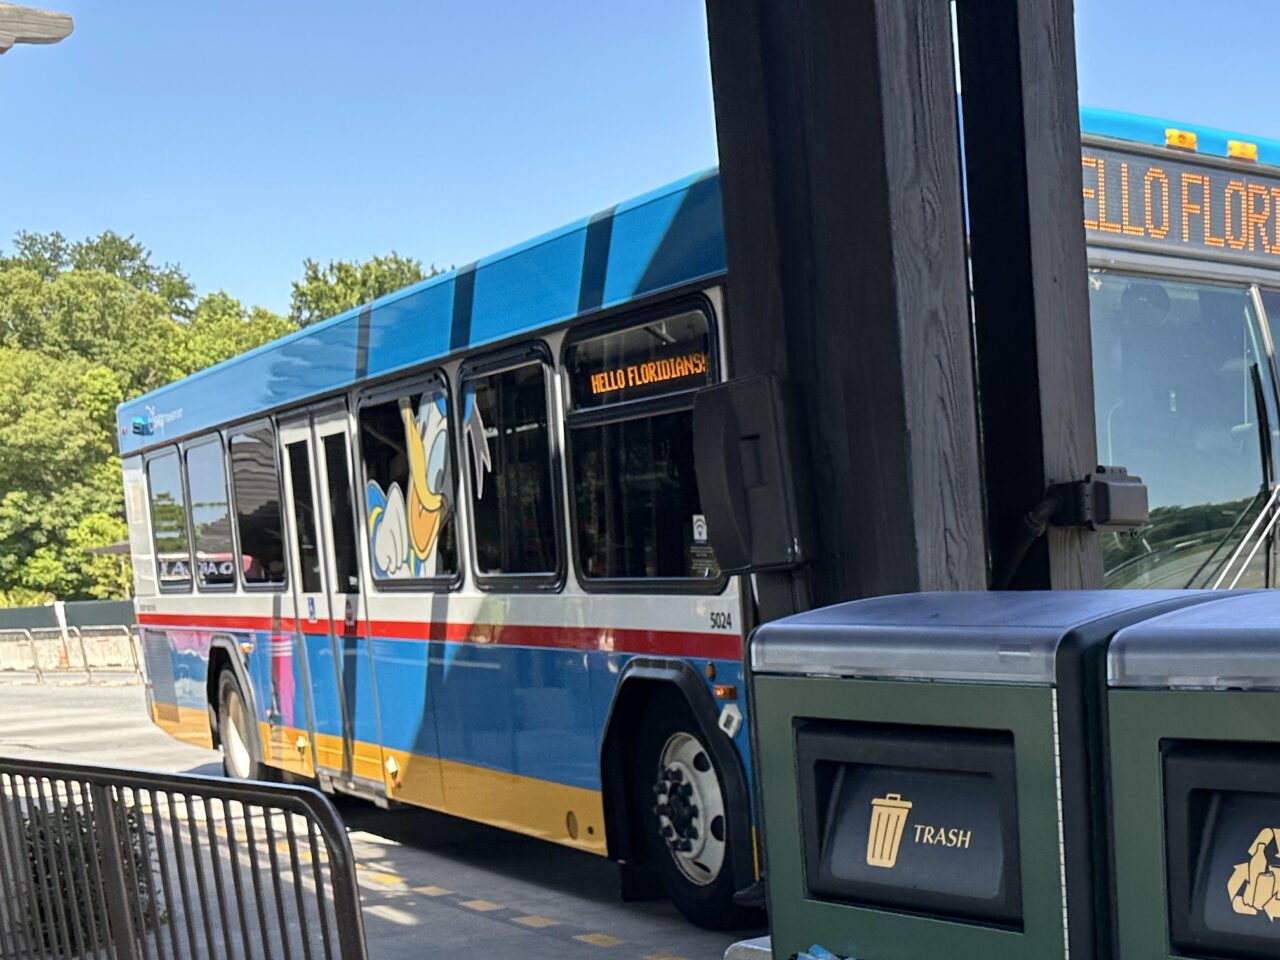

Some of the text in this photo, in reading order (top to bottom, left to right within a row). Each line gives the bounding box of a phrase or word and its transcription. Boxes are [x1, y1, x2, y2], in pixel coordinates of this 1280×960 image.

[1081, 155, 1169, 240] ELLO
[591, 353, 706, 394] HELLO FLORIDIANS!
[710, 612, 733, 629] 5024
[914, 824, 972, 849] TRASH
